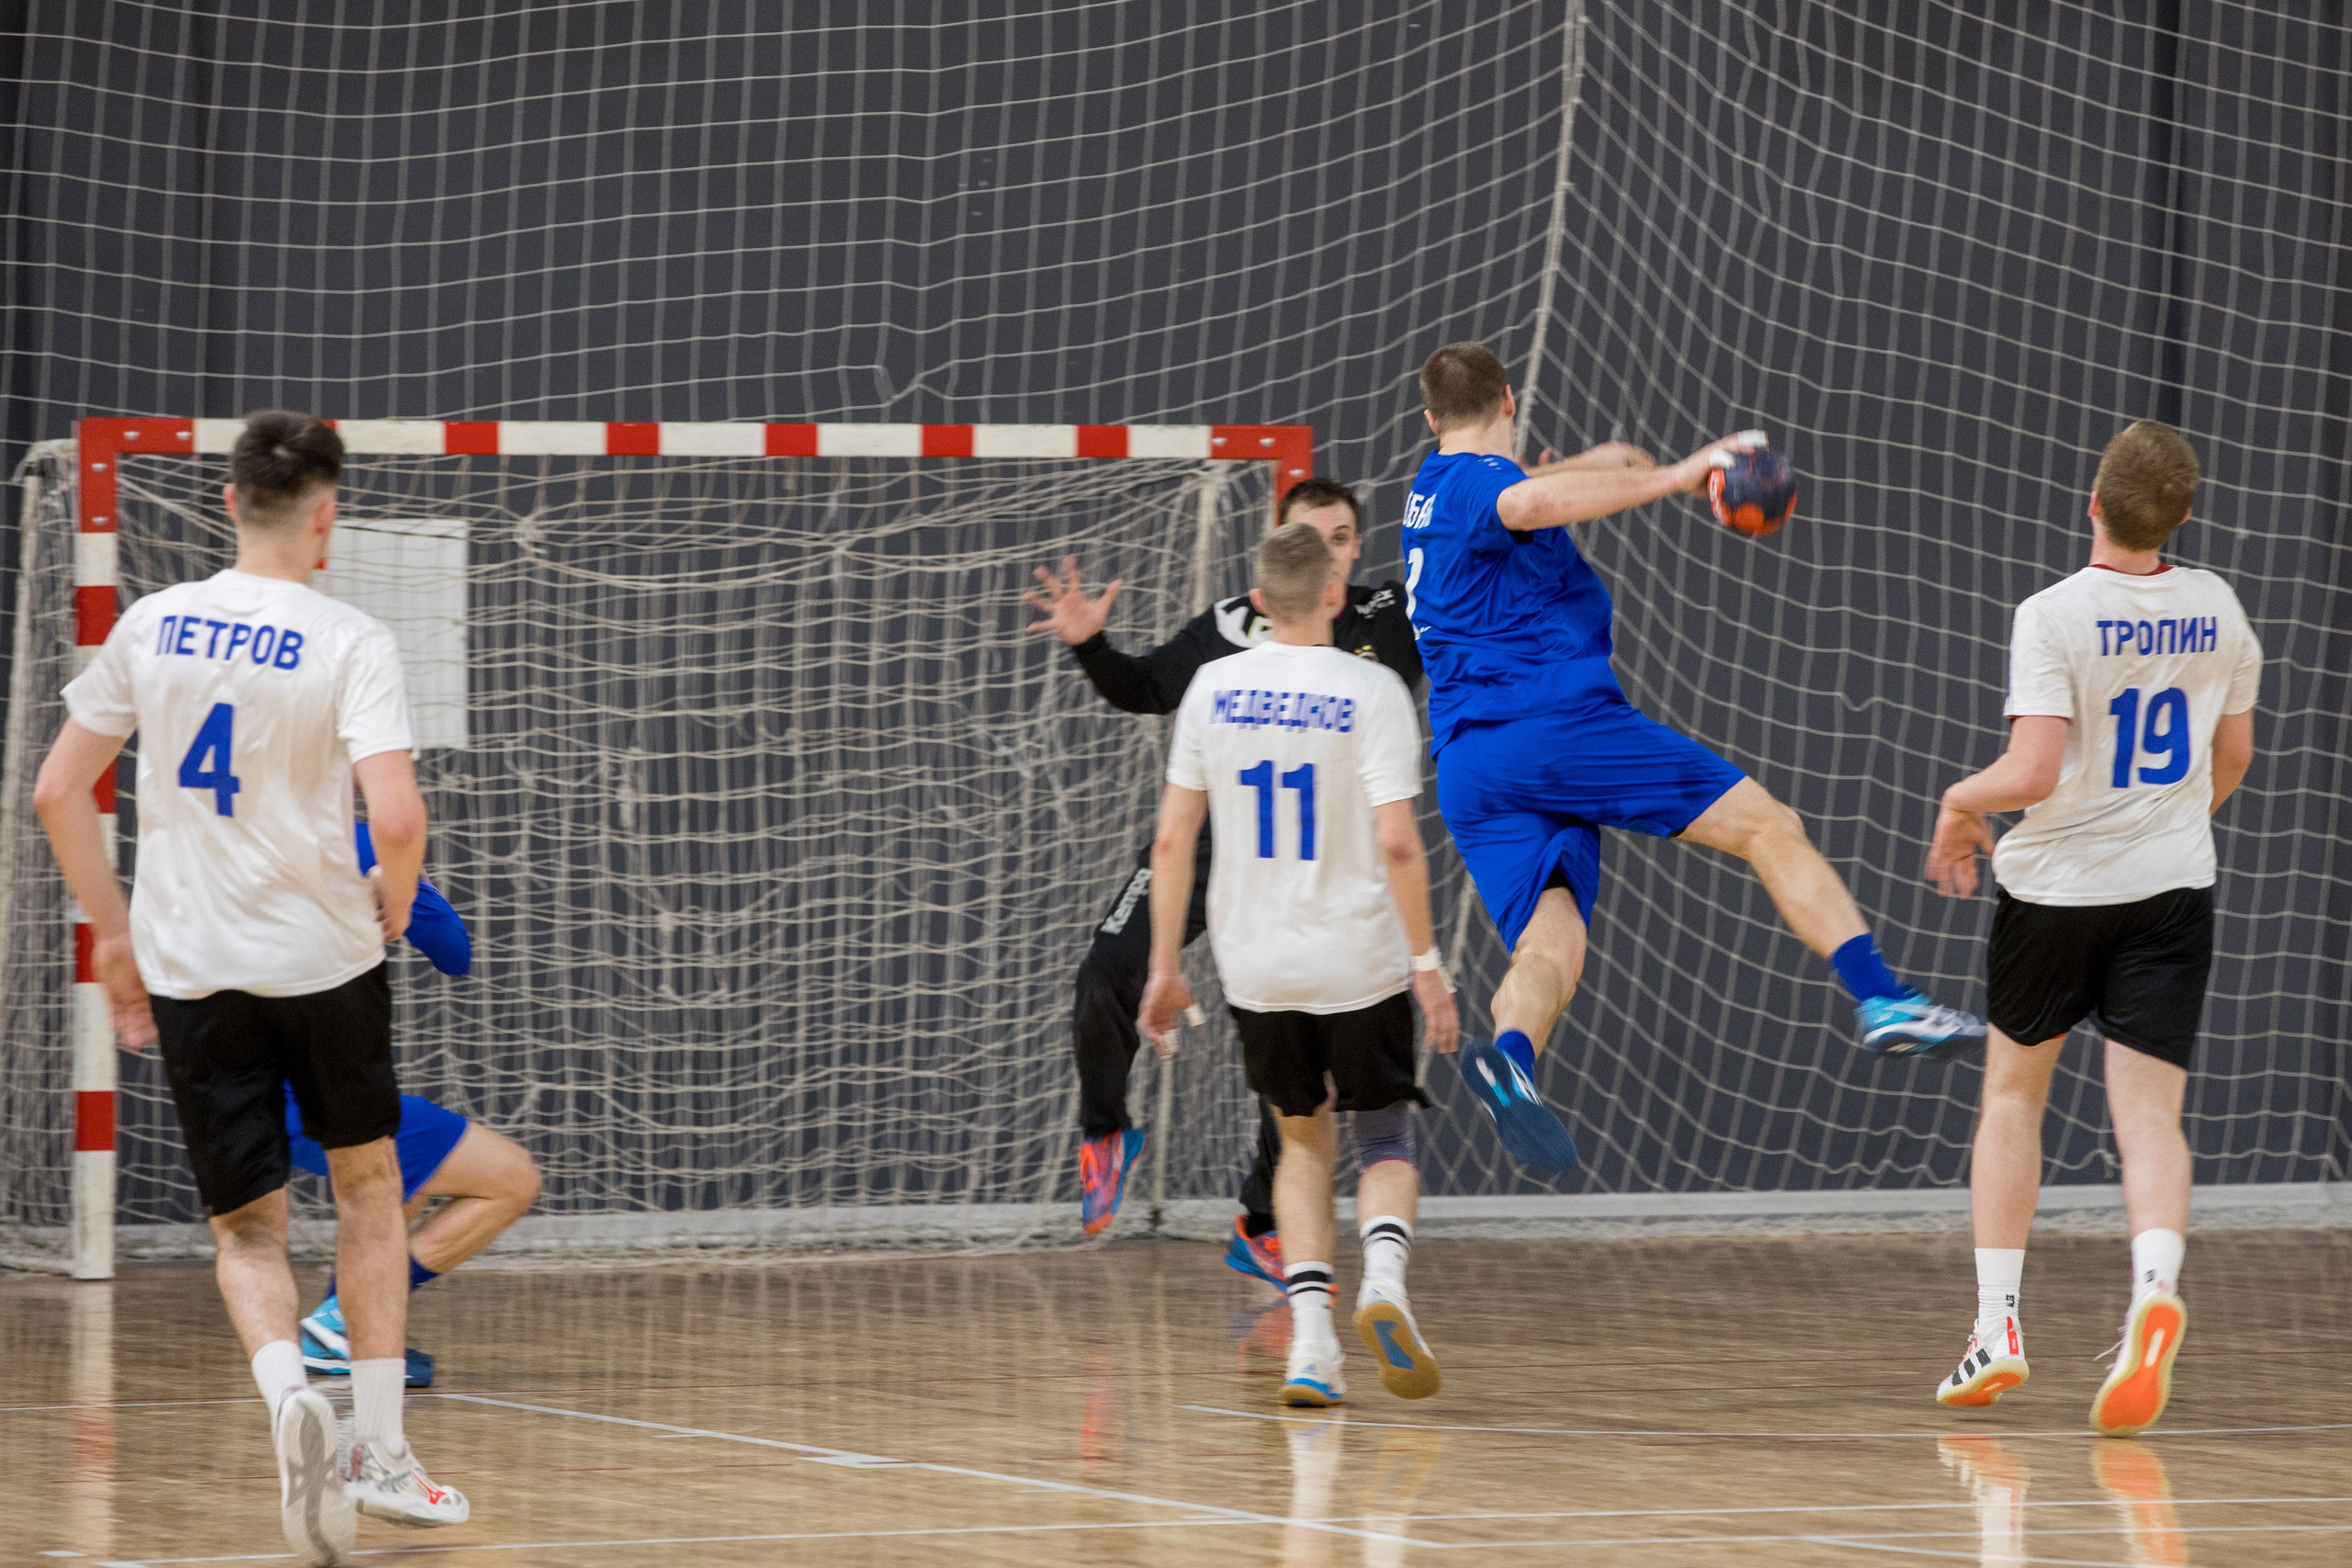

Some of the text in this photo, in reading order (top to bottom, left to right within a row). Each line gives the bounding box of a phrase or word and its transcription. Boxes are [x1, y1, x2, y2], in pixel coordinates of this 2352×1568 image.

[156, 615, 305, 671] ПЕТРОВ
[2096, 616, 2217, 656] ТРОПИН
[177, 702, 241, 818] 4
[2109, 687, 2191, 788] 19
[1238, 760, 1317, 861] 11
[1100, 867, 1153, 935] Kempa
